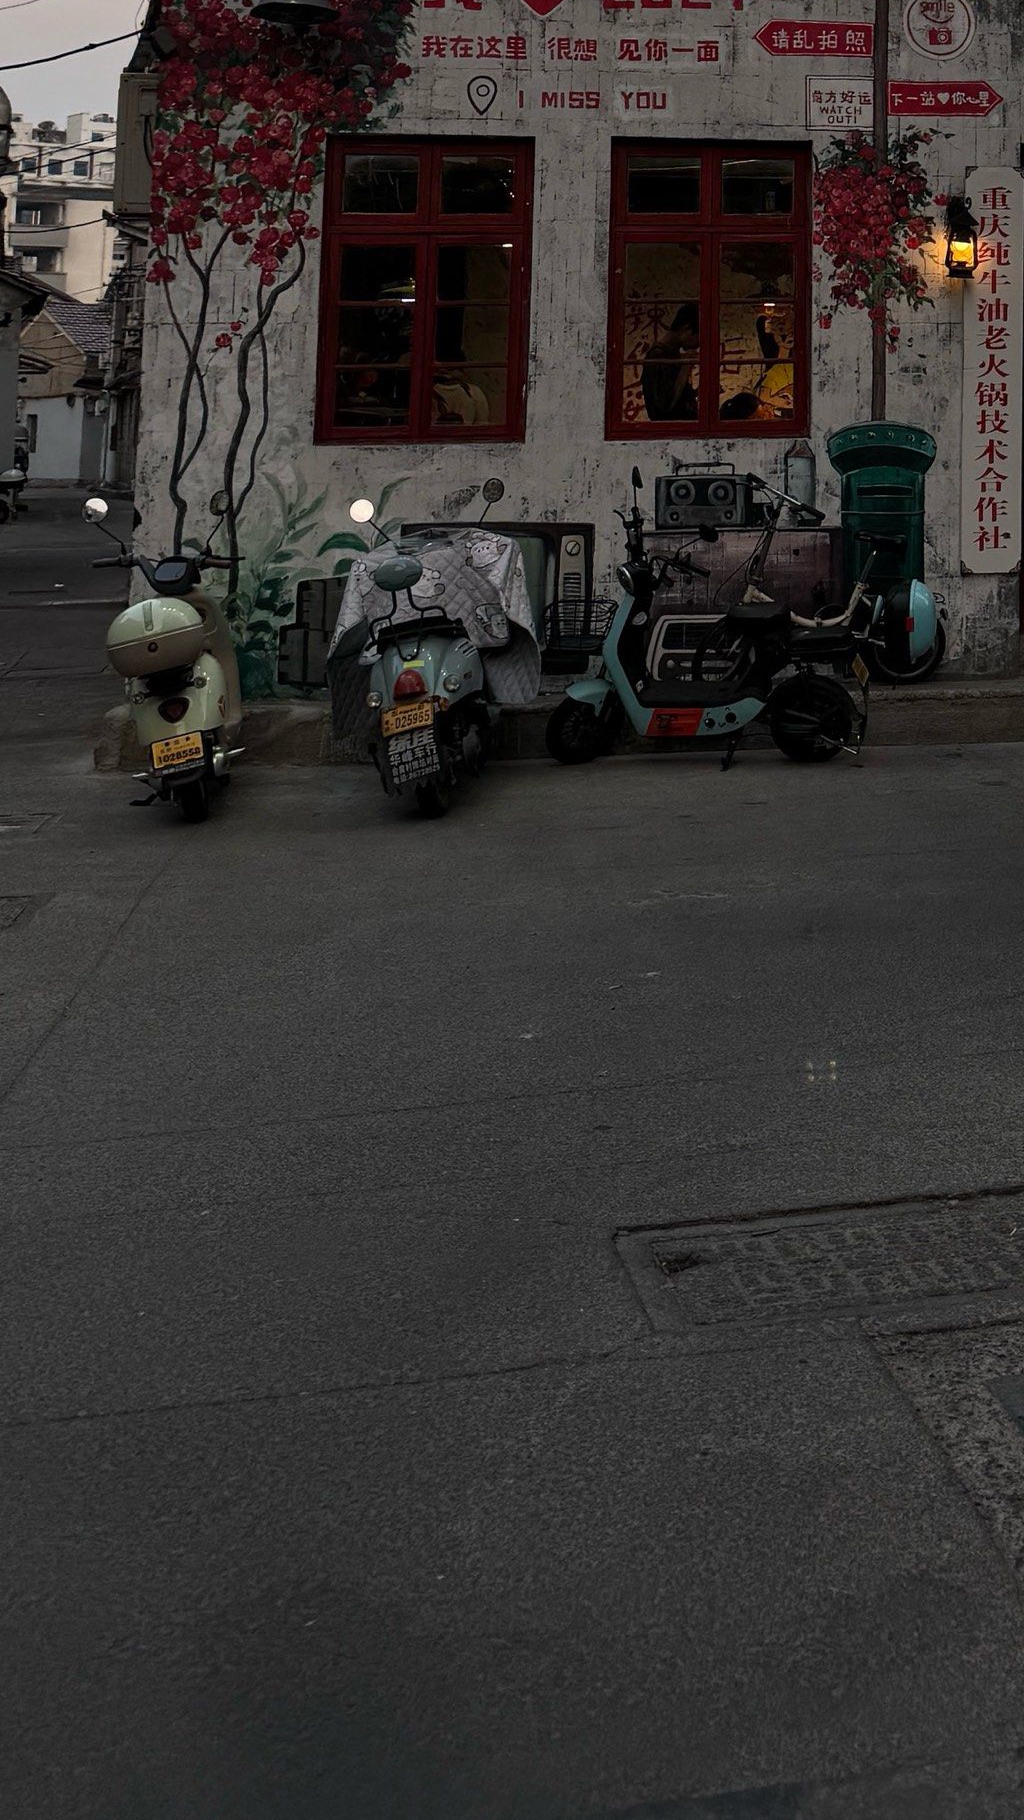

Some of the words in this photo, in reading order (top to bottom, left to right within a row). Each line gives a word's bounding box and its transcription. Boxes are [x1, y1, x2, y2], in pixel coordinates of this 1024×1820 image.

[422, 35, 527, 60] 我在这里
[548, 37, 597, 61] 很想
[619, 38, 719, 62] 见你一面
[771, 29, 867, 52] 请乱拍照
[518, 90, 524, 108] I
[541, 91, 600, 110] MISS
[621, 91, 667, 110] YOU
[813, 90, 872, 105] 前方好运
[891, 91, 935, 107] 下一站
[819, 106, 862, 115] WATCH
[973, 186, 1012, 553] 重庆纯牛油老火锅技术合作社
